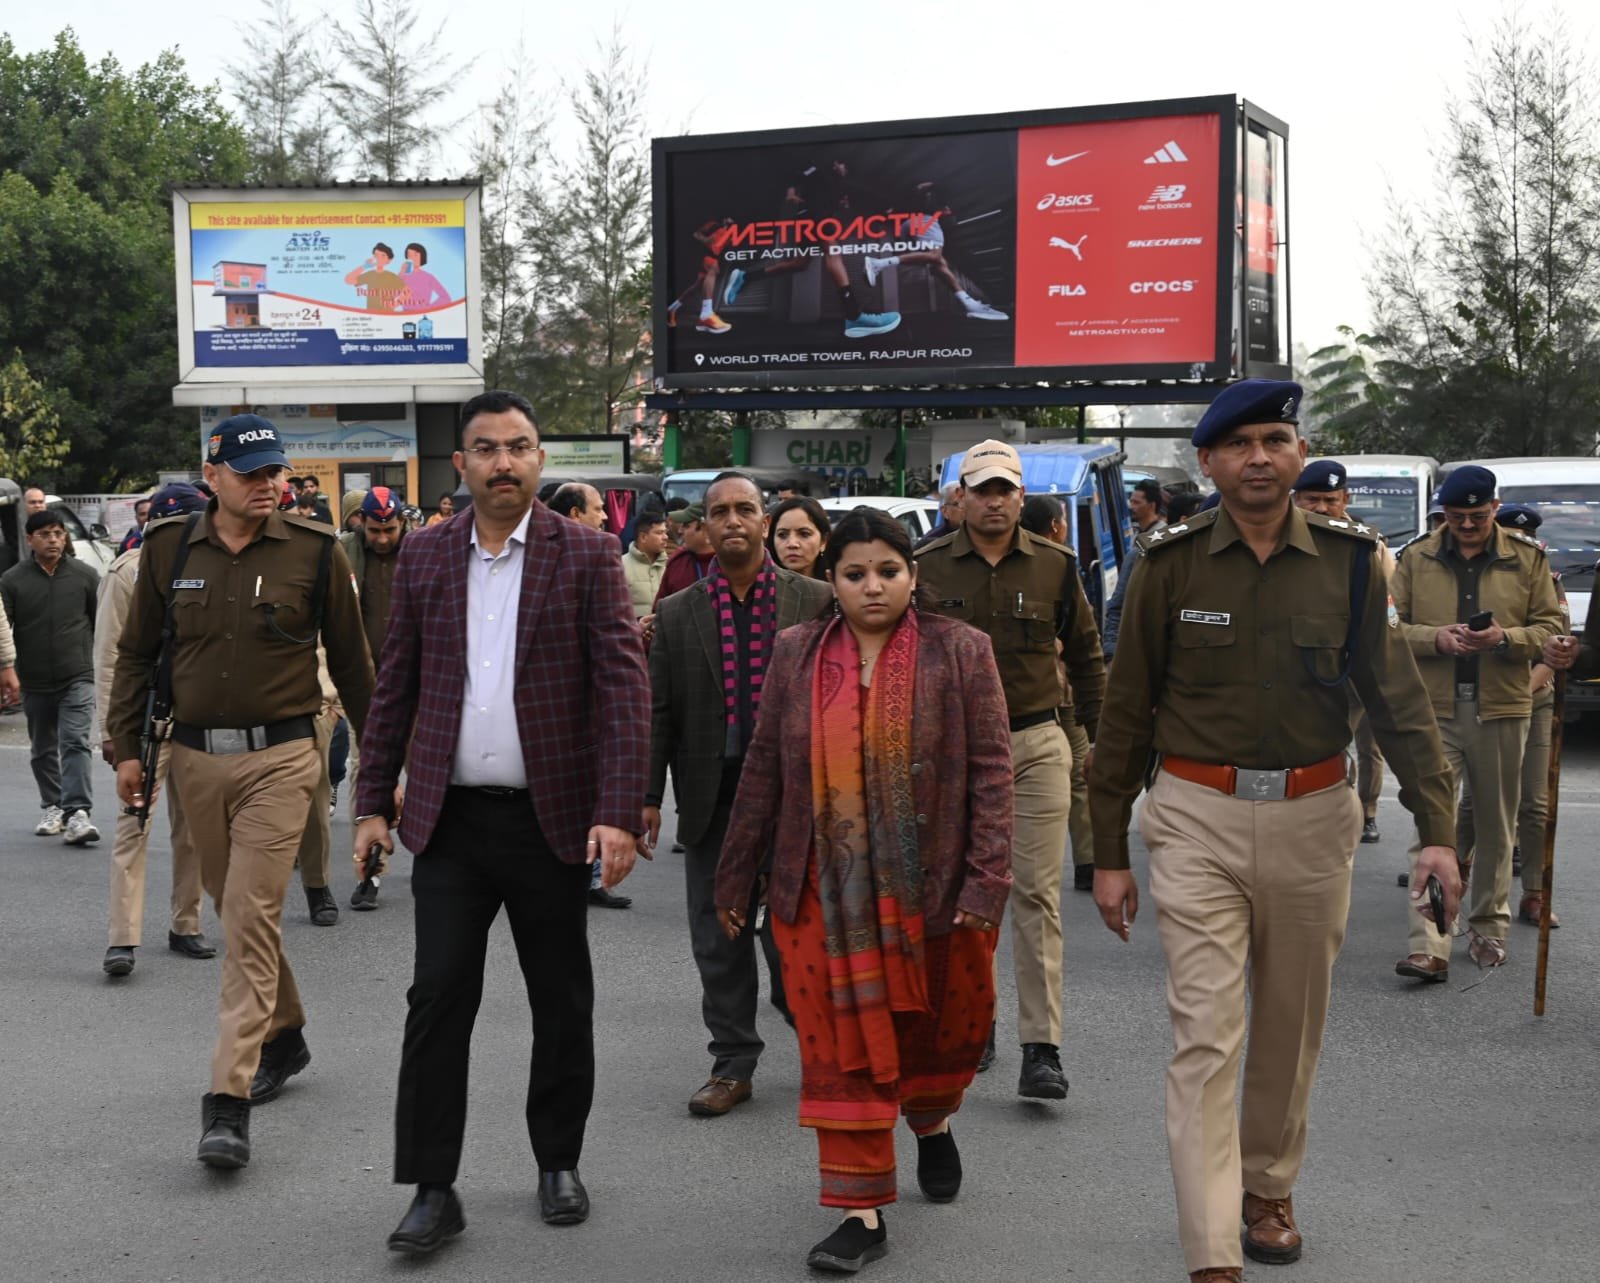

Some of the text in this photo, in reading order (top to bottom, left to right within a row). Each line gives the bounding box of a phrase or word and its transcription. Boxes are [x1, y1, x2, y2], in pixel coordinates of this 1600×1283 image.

[1055, 194, 1093, 207] asics
[1159, 202, 1192, 210] balance
[208, 215, 224, 226] This
[226, 215, 241, 226] site
[244, 215, 280, 225] available
[282, 215, 294, 225] for
[296, 214, 353, 225] advertisement
[355, 213, 384, 224] Contact
[719, 211, 943, 247] METROACTIV
[286, 237, 331, 247] AXIS
[1127, 237, 1202, 248] SKECHERS
[725, 250, 759, 261] GET
[1049, 284, 1086, 296] FILA
[1129, 280, 1193, 293] crocs
[302, 308, 320, 320] 24
[1069, 327, 1165, 336] METROACTIV.COM
[710, 355, 758, 364] WORLD
[762, 354, 808, 362] TRADE
[870, 350, 927, 359] RAJPUR
[931, 348, 972, 357] ROAD
[238, 429, 276, 444] POLICE
[1050, 484, 1057, 492] 3
